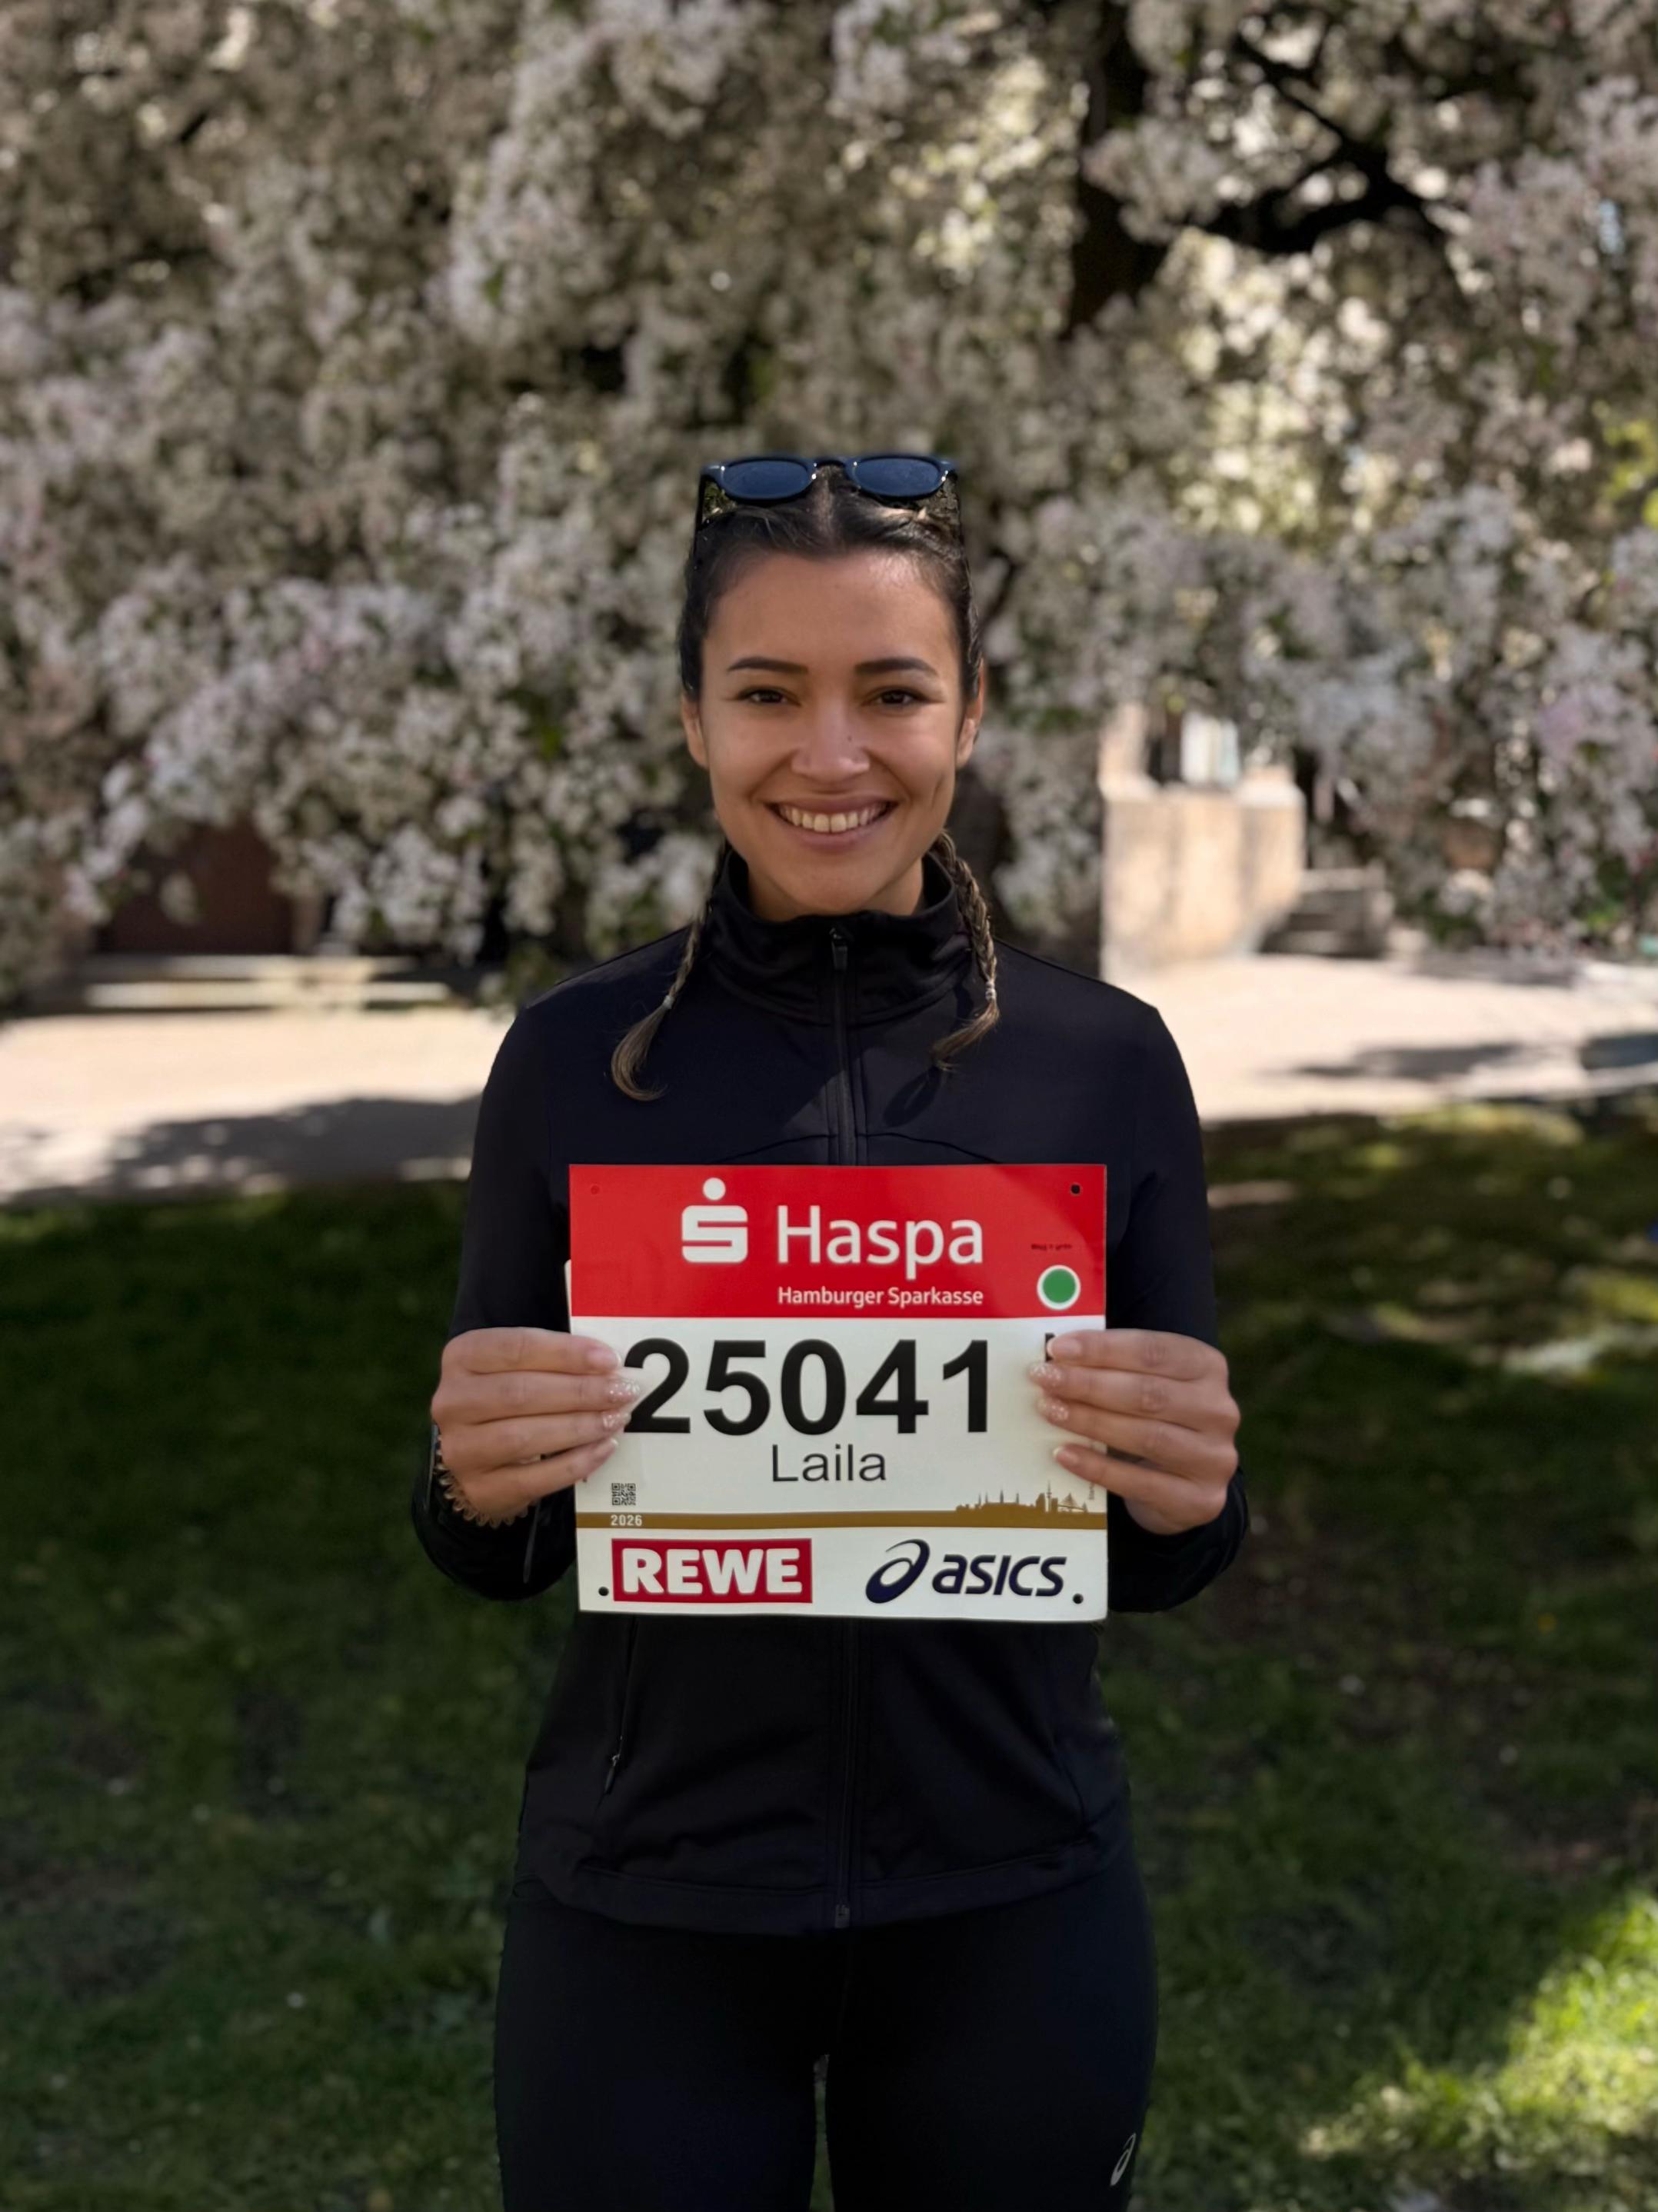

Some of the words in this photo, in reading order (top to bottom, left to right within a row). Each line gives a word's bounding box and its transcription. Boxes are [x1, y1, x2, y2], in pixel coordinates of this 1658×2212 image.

[777, 1205, 983, 1280] Haspa
[778, 1286, 883, 1308] Hamburger
[888, 1287, 984, 1308] Sparkasse
[624, 1338, 987, 1436] 25041
[771, 1444, 887, 1482] Laila
[611, 1514, 643, 1527] 2026
[621, 1547, 802, 1594] REWE
